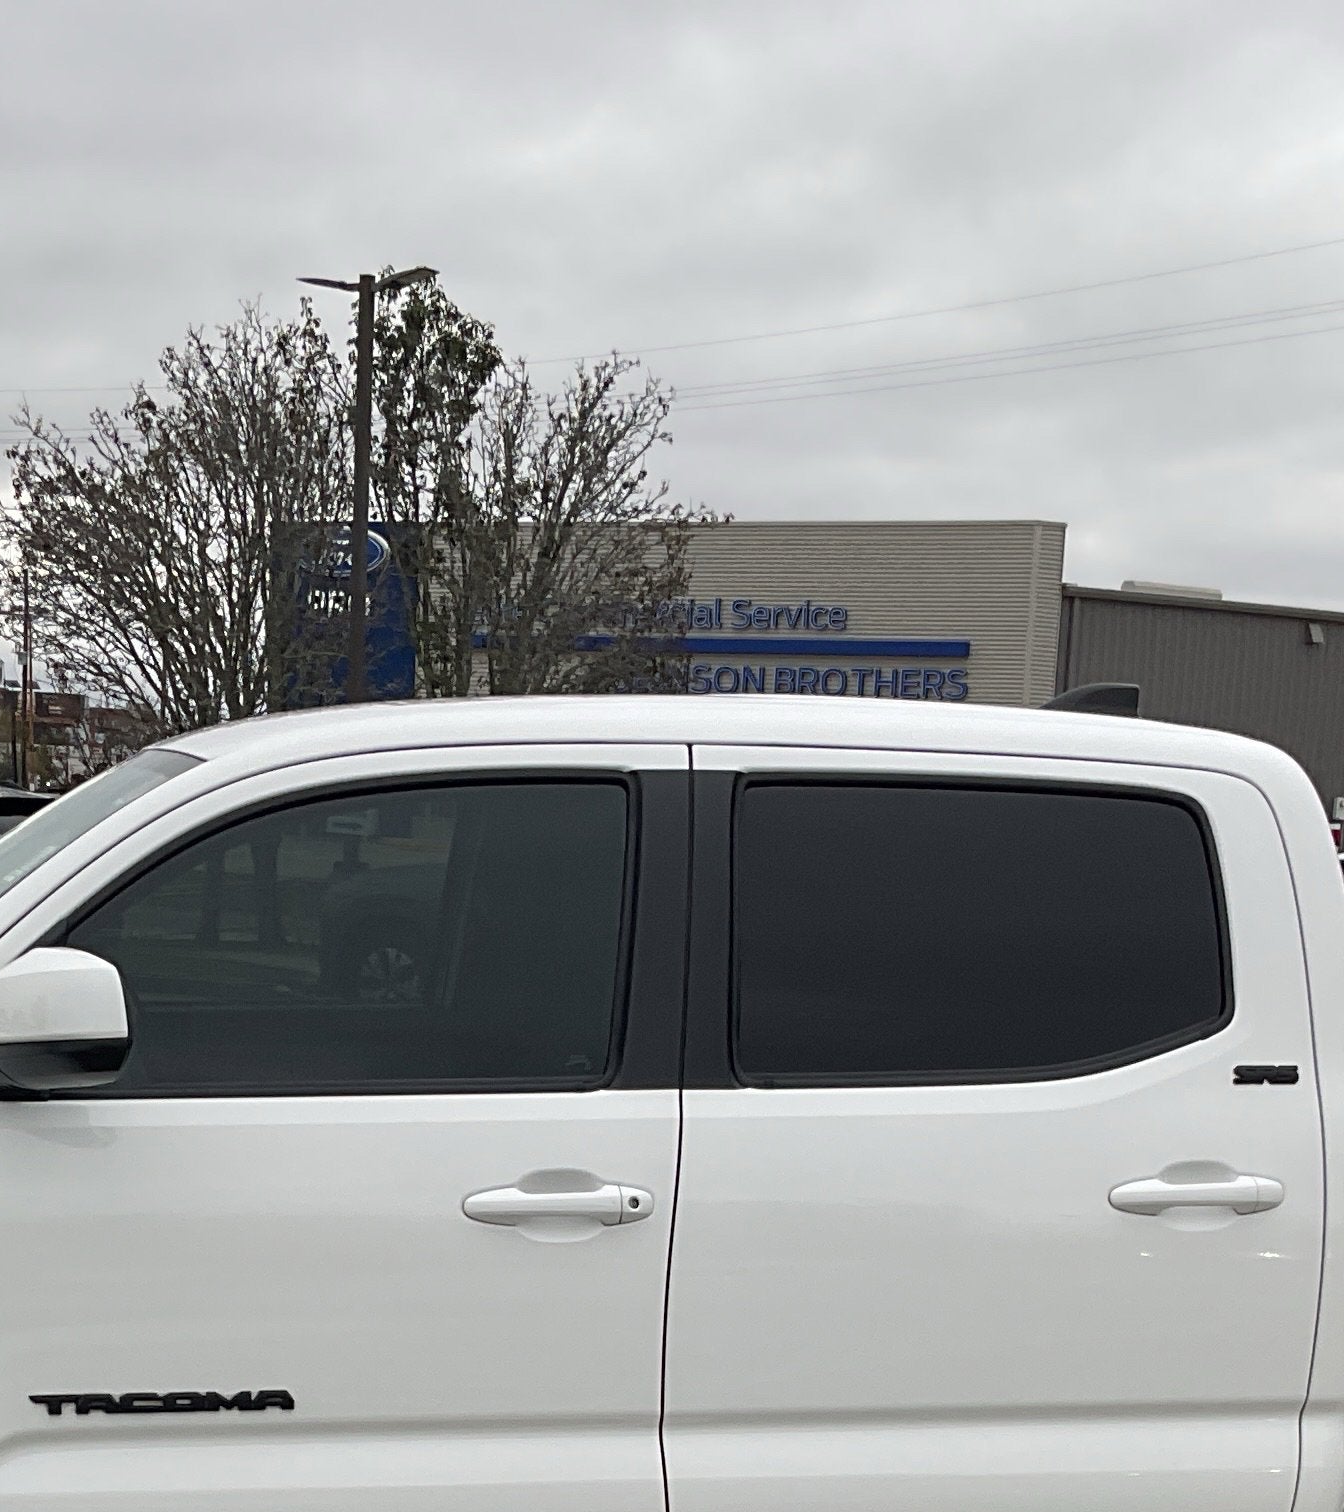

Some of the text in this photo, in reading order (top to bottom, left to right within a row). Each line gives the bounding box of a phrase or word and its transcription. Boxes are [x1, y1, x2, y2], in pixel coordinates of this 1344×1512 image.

[730, 600, 848, 631] Service
[773, 664, 969, 700] BROTHERS
[1232, 1064, 1299, 1085] SR5
[28, 1389, 295, 1416] TACOMA
